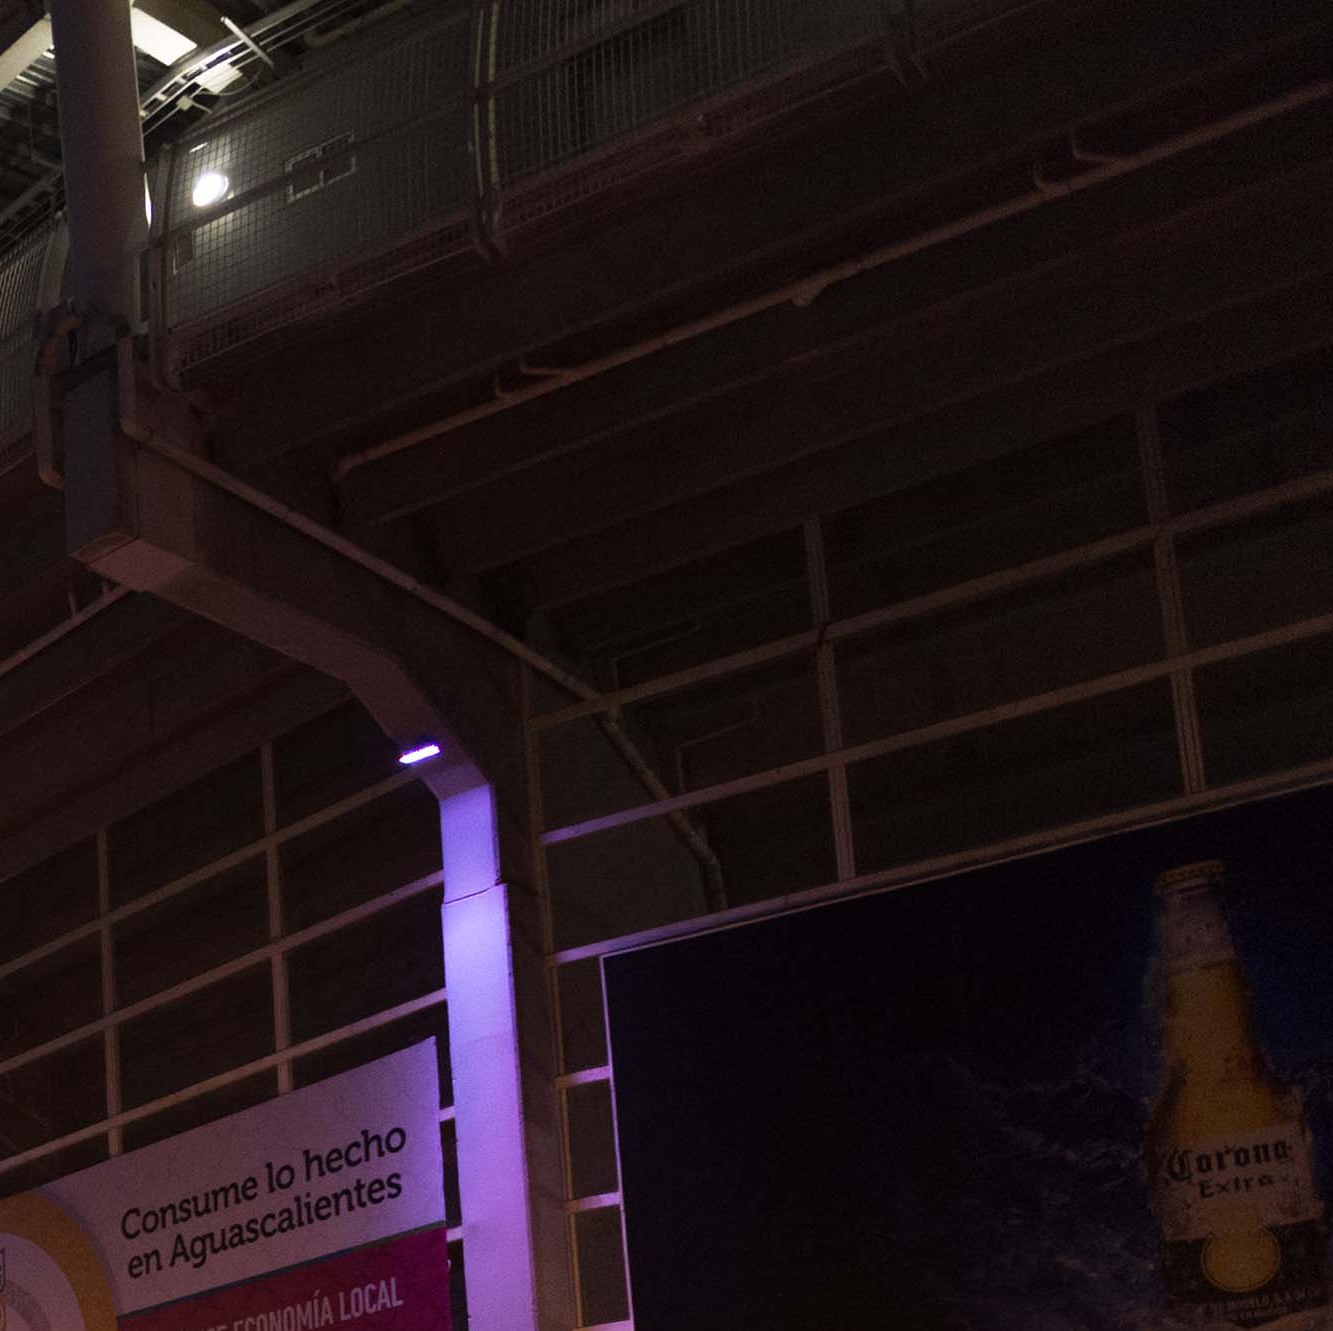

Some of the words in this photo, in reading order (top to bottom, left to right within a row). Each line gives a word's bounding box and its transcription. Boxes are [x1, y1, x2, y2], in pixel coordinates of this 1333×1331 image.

[121, 1176, 258, 1240] Consume
[265, 1162, 295, 1194] lo
[302, 1127, 407, 1181] hecho
[128, 1249, 162, 1279] en
[168, 1173, 402, 1268] Aguascalientes
[338, 1276, 404, 1321] LOCAL
